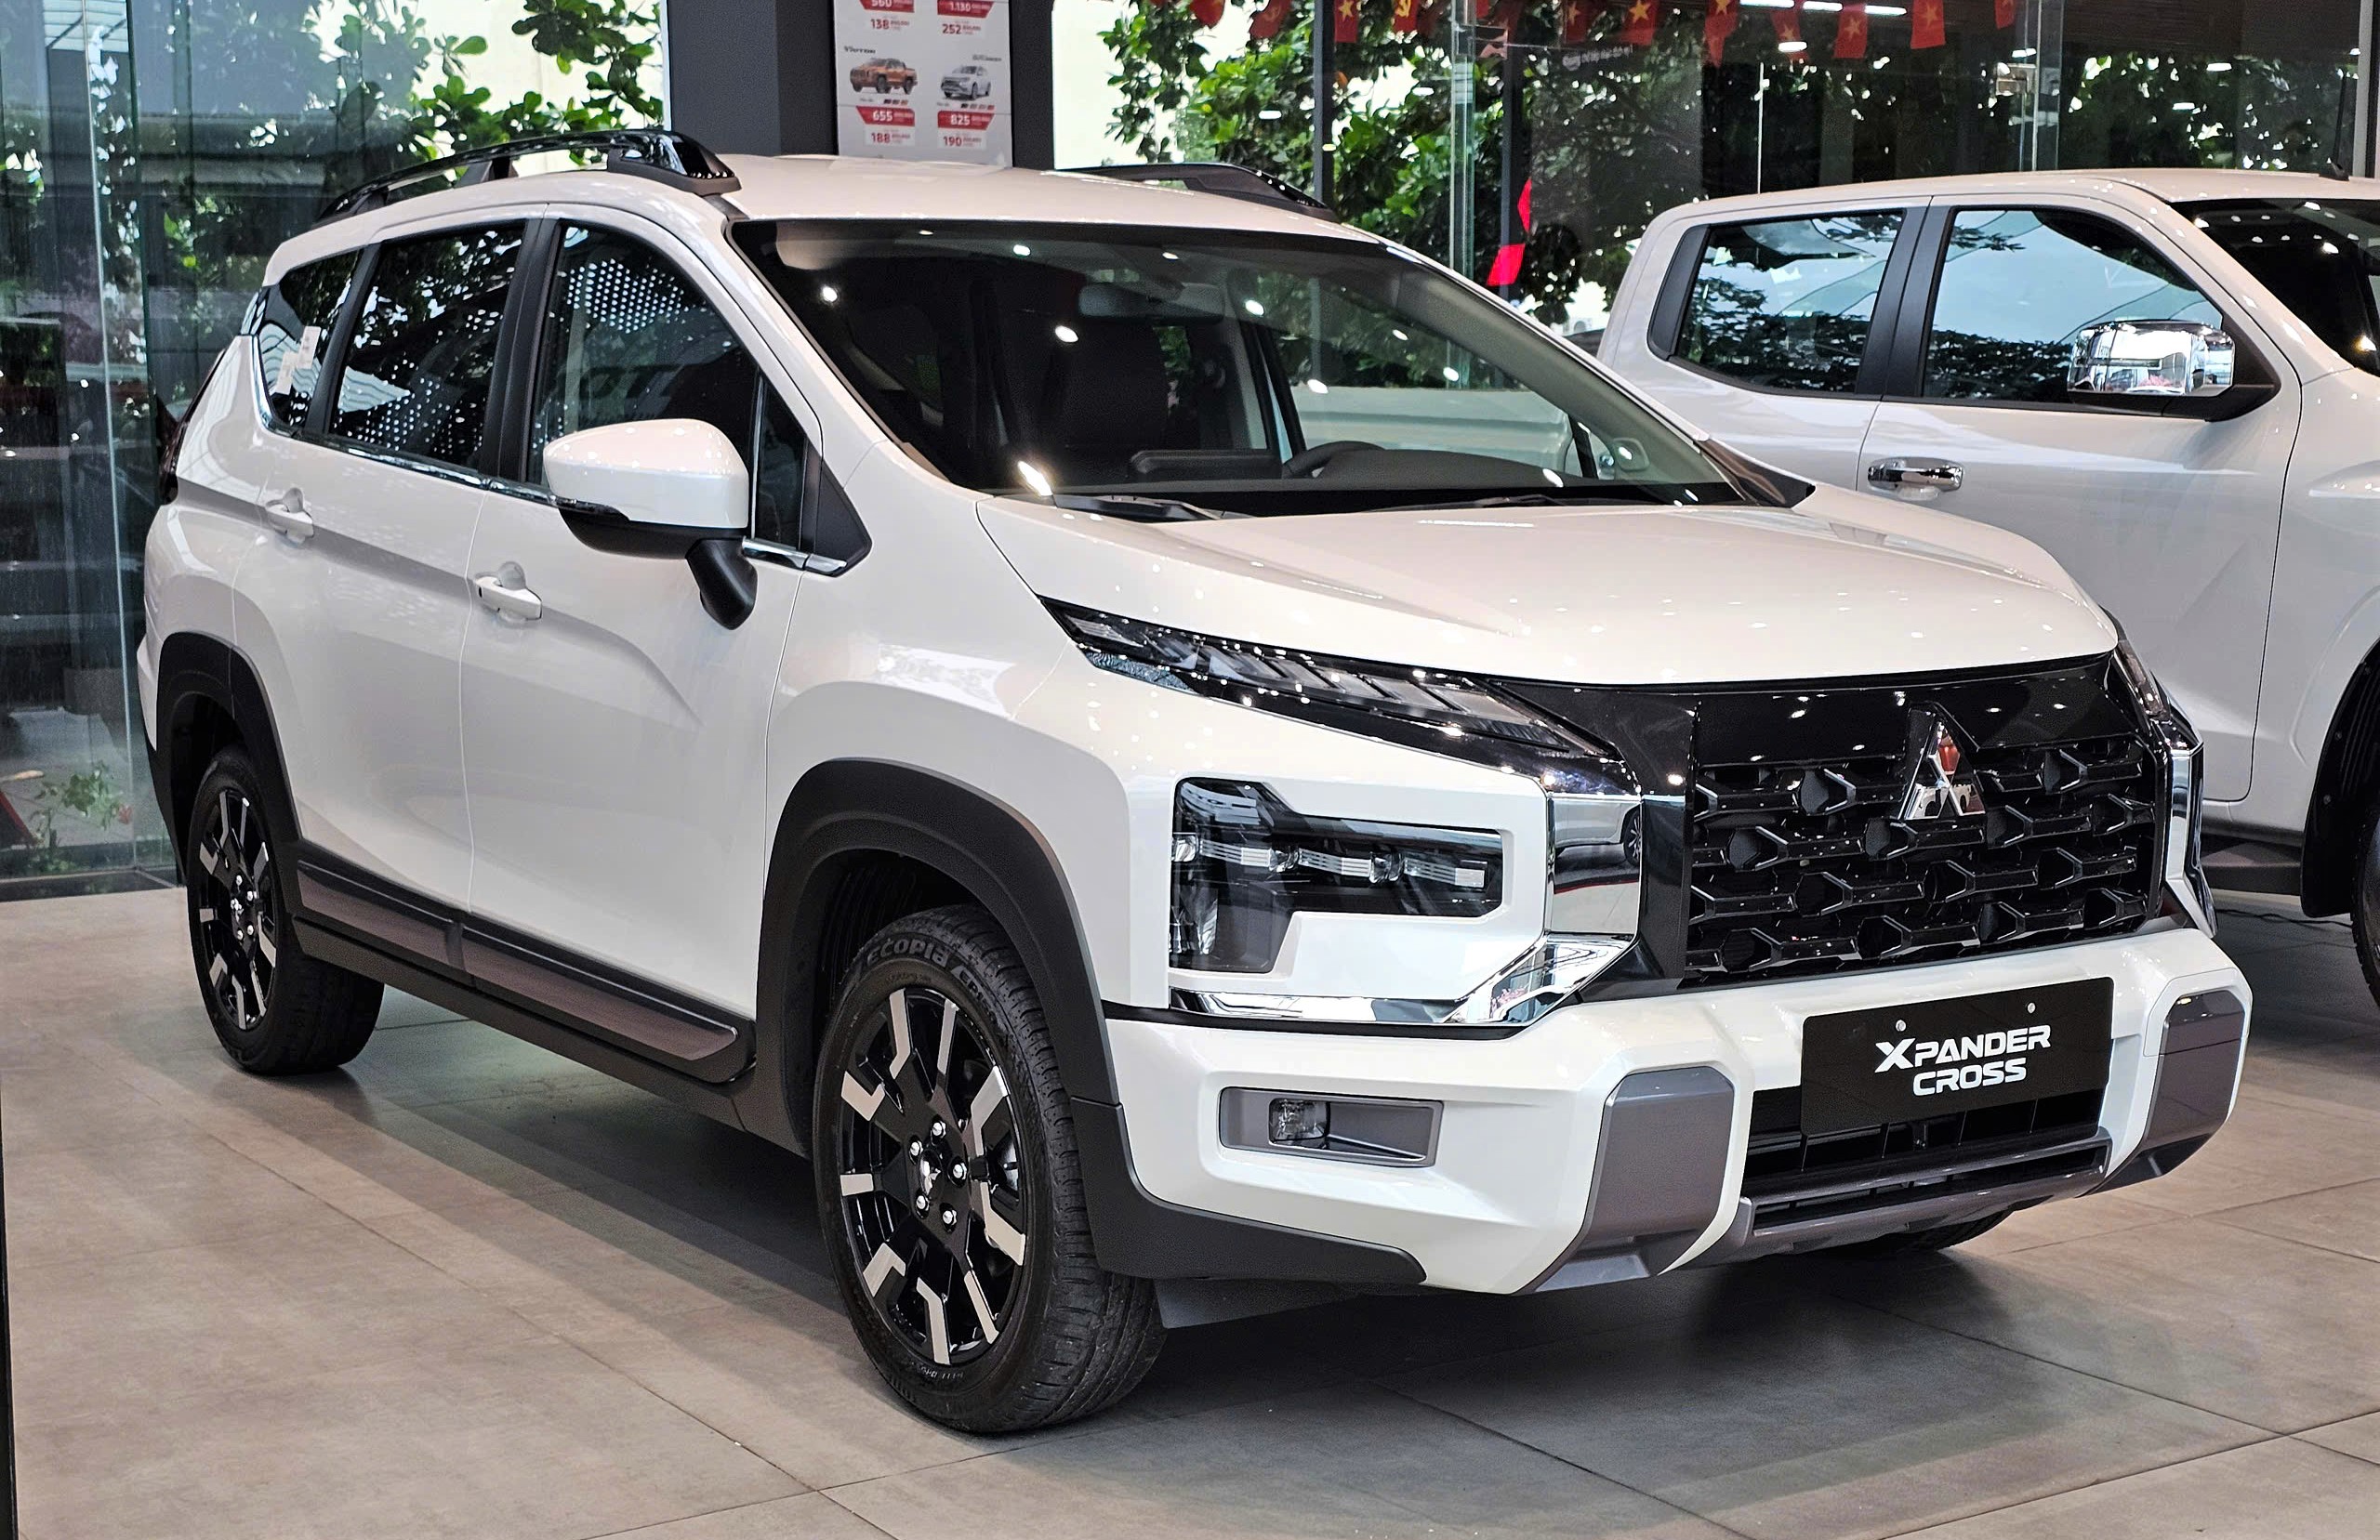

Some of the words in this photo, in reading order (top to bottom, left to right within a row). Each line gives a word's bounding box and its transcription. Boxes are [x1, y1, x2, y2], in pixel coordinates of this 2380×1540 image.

[942, 24, 962, 34] 252
[873, 111, 892, 122] 655
[950, 114, 971, 125] 825
[944, 136, 962, 147] 190
[1874, 1025, 2051, 1073] XPANDER
[1912, 1058, 2027, 1096] CROSS
